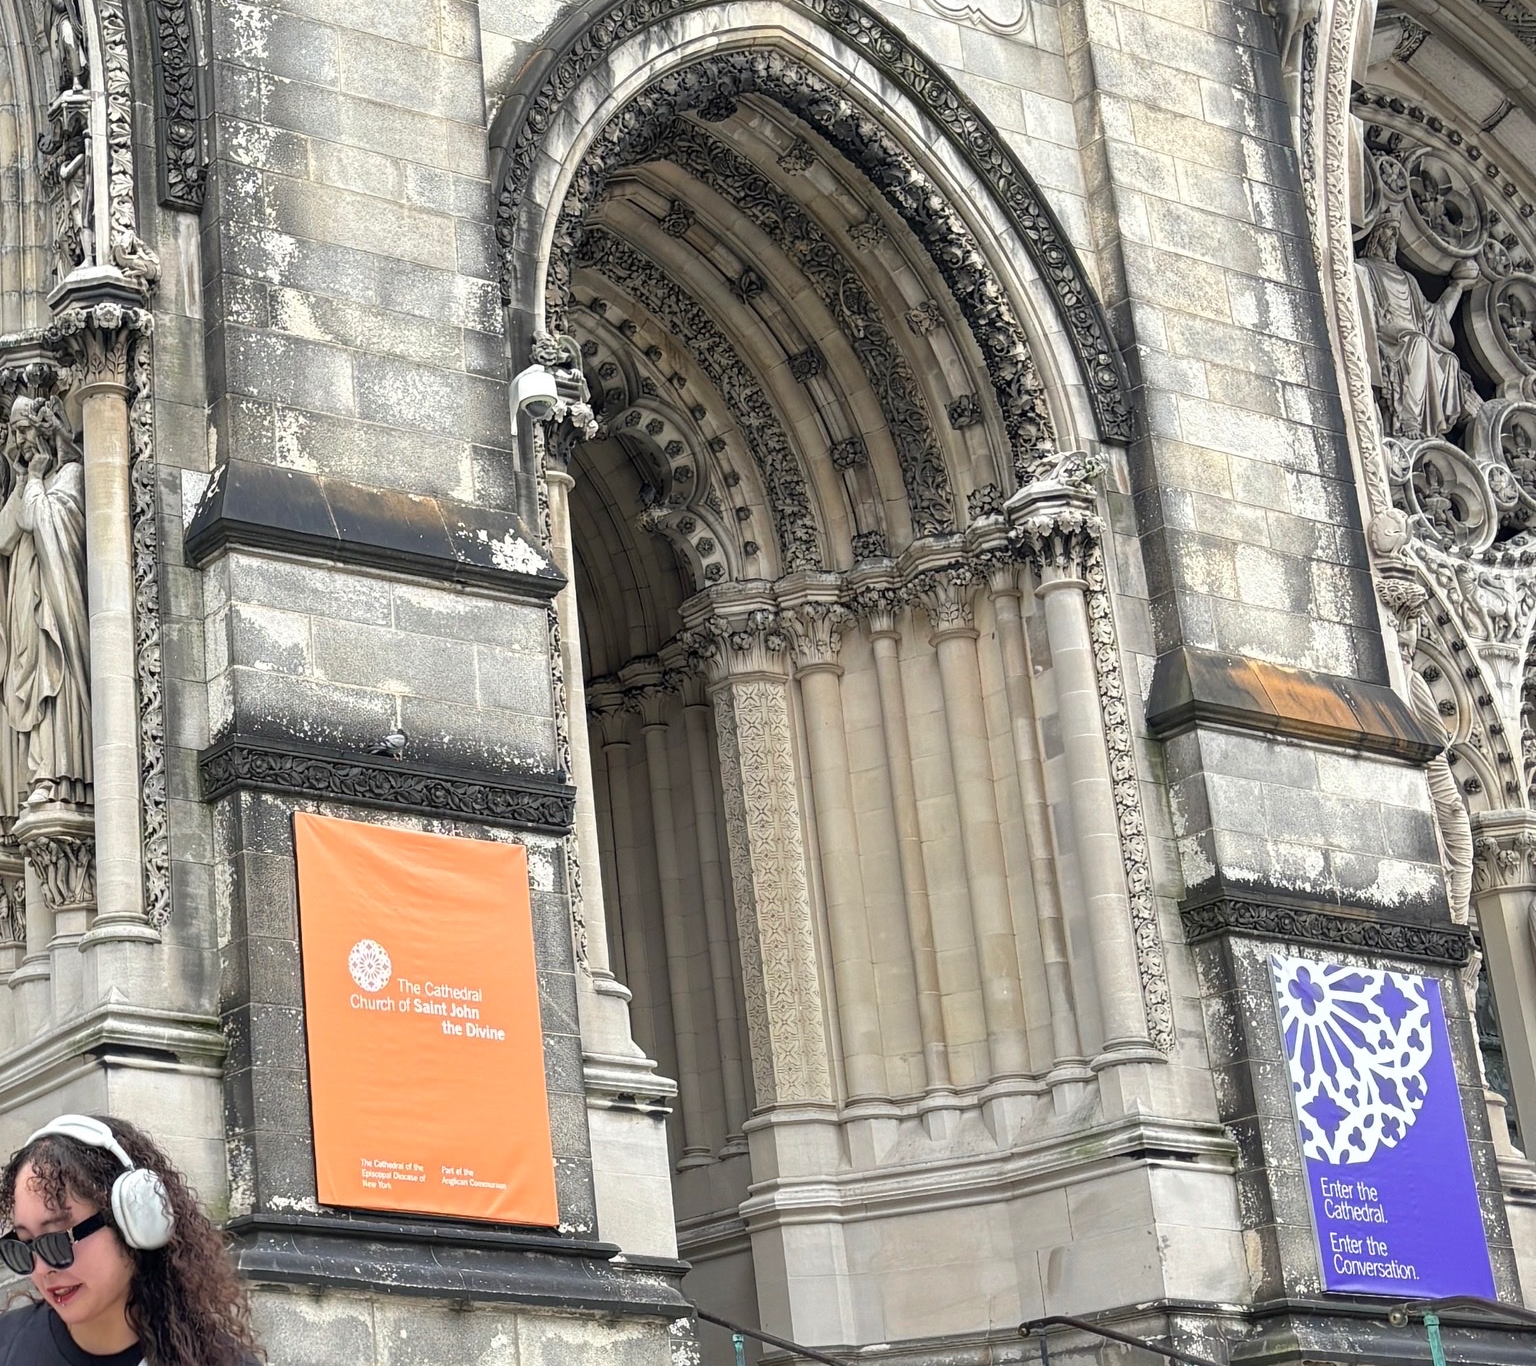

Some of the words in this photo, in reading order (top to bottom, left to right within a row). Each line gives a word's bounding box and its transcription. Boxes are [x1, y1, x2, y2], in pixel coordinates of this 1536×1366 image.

[397, 978, 421, 996] The
[424, 981, 483, 1002] Cathedral
[350, 993, 396, 1012] Church
[398, 998, 411, 1013] of
[414, 998, 448, 1016] Saint
[449, 1003, 480, 1020] John
[441, 1020, 463, 1036] the
[465, 1022, 506, 1041] Divine
[360, 1158, 372, 1168] The
[373, 1159, 405, 1171] Cathedral
[405, 1162, 412, 1171] of
[413, 1163, 424, 1172] the
[361, 1168, 392, 1180] Episcopal
[419, 1174, 426, 1182] of
[441, 1165, 455, 1175] Part
[456, 1167, 463, 1176] of
[463, 1167, 474, 1177] the
[362, 1179, 377, 1188] New
[377, 1180, 392, 1190] York
[441, 1176, 468, 1187] Anglican
[1320, 1177, 1353, 1199] Enter
[1356, 1181, 1378, 1202] the
[1324, 1198, 1388, 1224] Cathedral.
[1329, 1232, 1363, 1255] Enter
[1366, 1236, 1388, 1257] the
[1333, 1253, 1420, 1280] Conversation.
